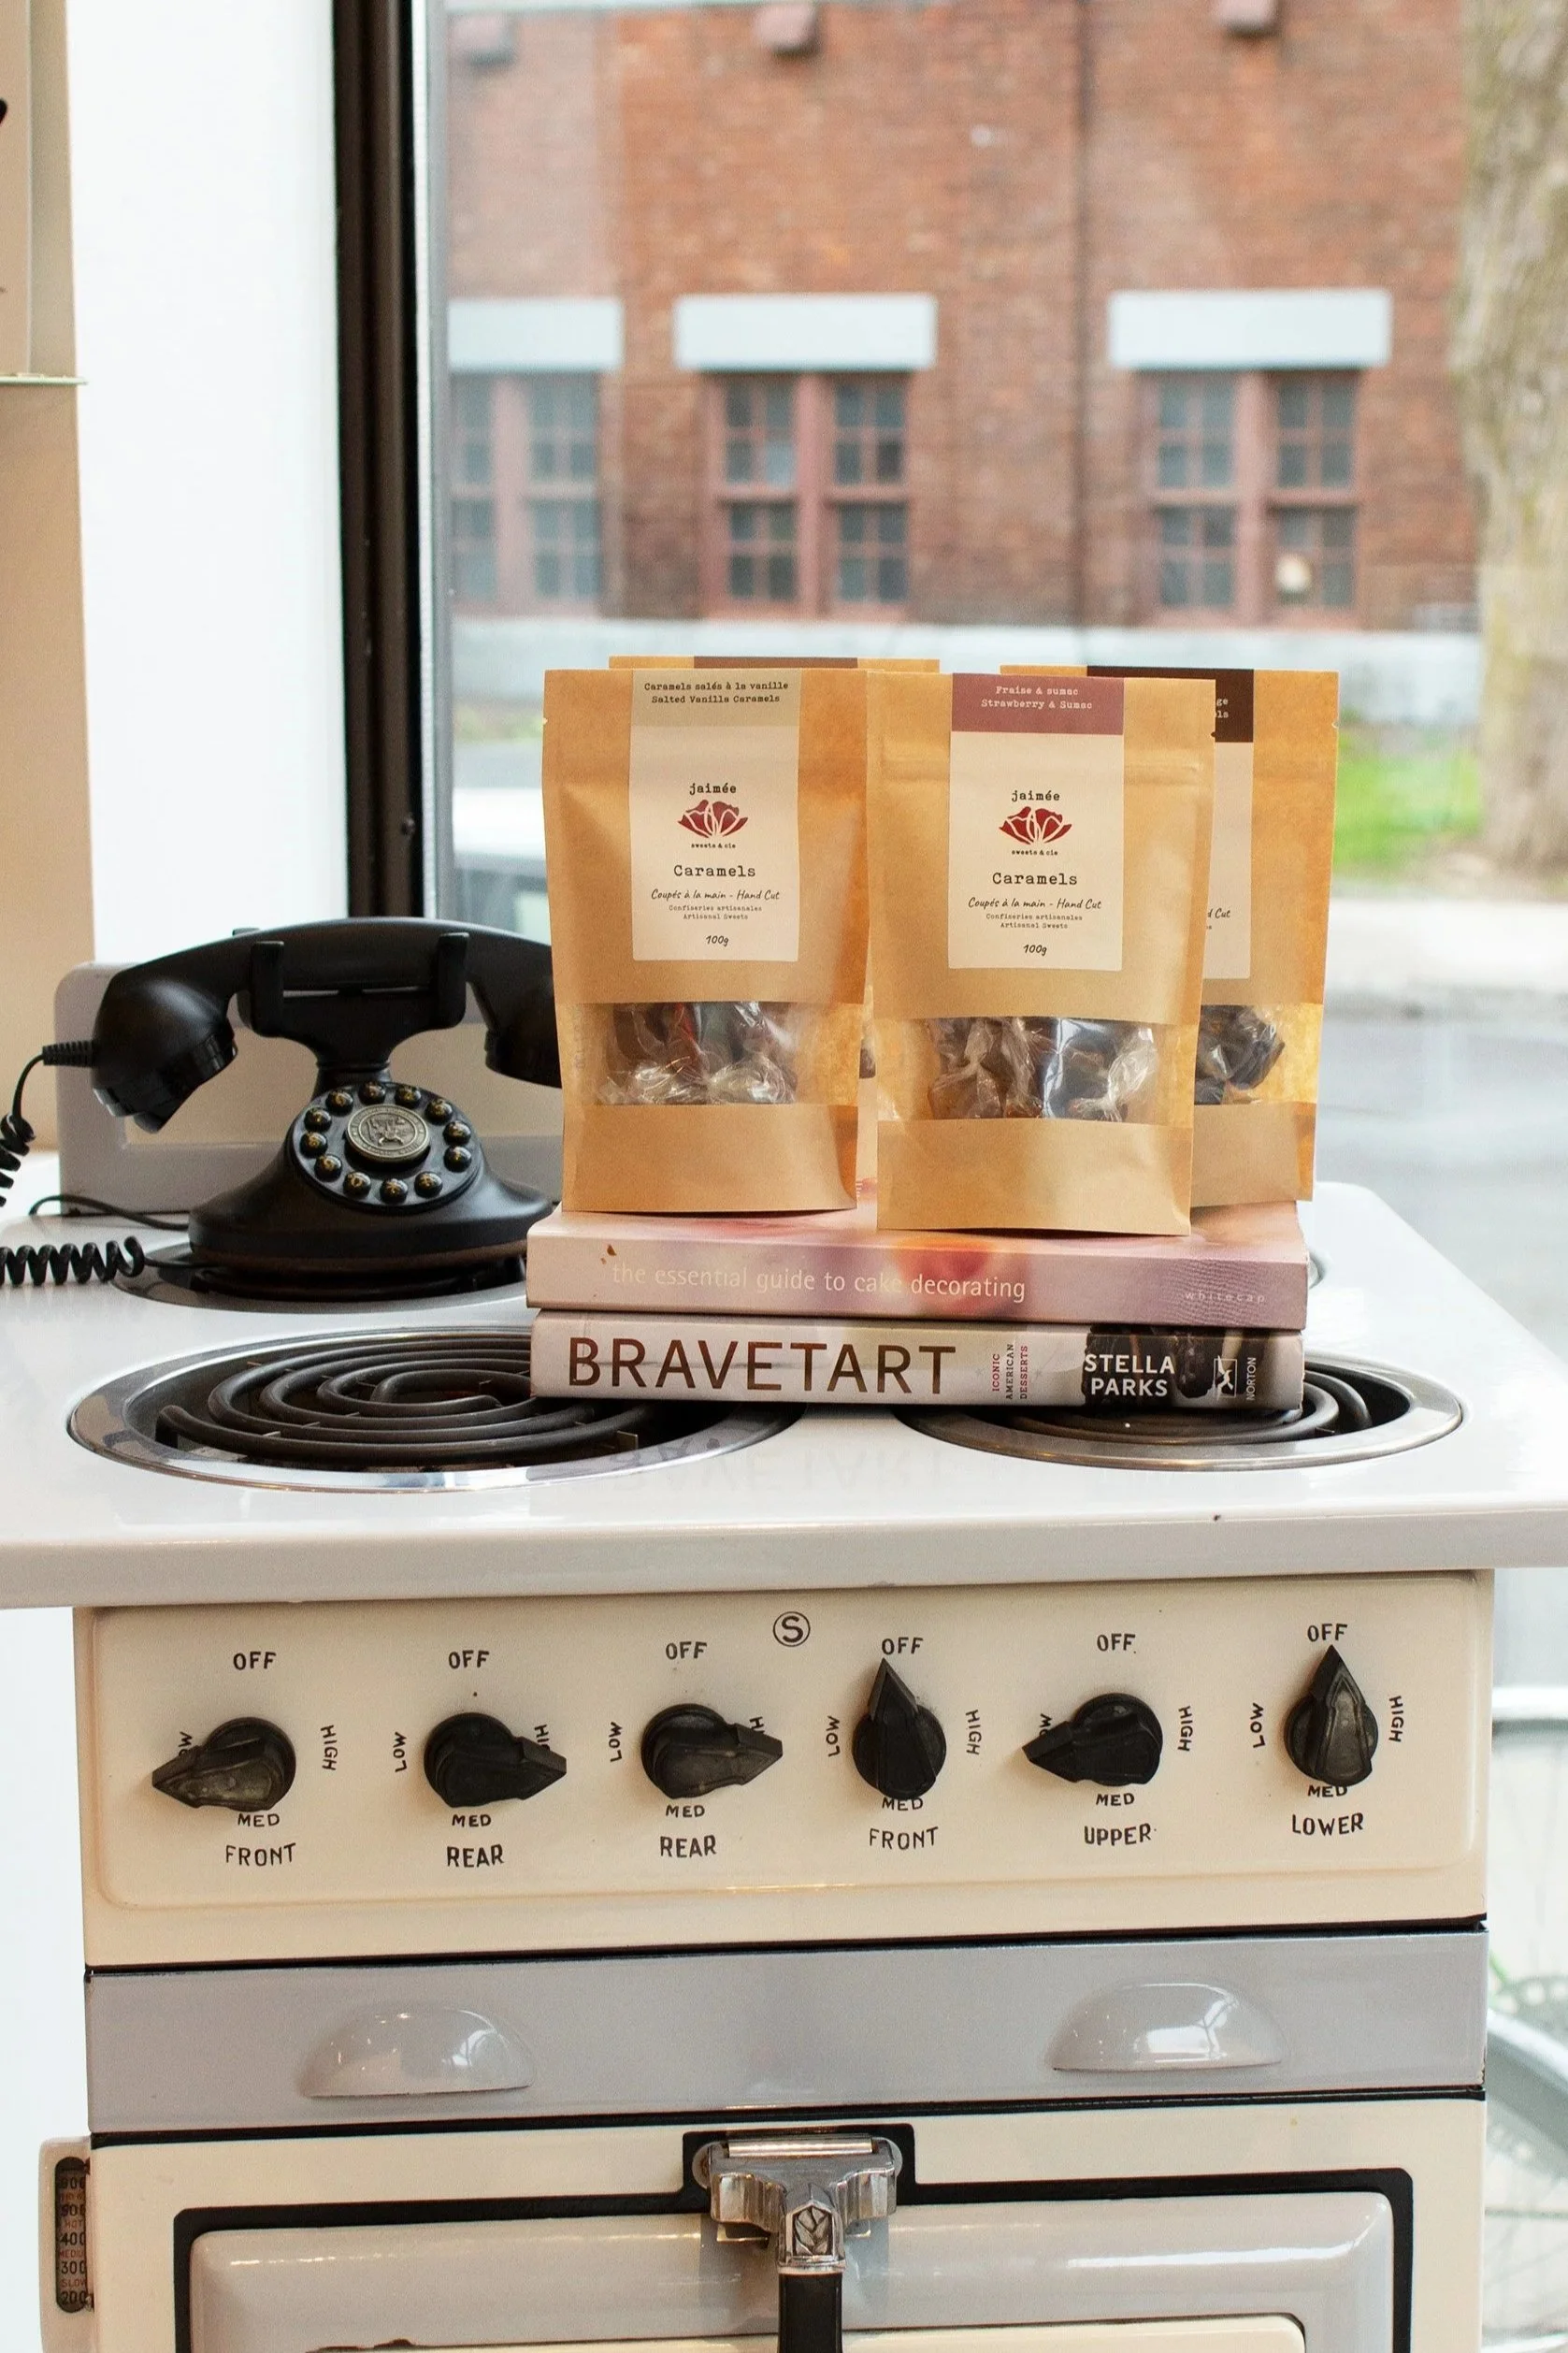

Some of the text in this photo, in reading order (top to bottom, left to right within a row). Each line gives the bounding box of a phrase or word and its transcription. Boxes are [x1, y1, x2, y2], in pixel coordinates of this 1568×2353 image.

[644, 682, 788, 691] Caramels salés à la vanille
[995, 686, 1079, 696] Fraise & sumac
[652, 695, 685, 703] Salted
[690, 695, 729, 703] Vanilla
[981, 699, 1092, 710] Strawberry & Sumac
[688, 783, 737, 797] jaimée
[1011, 789, 1061, 803] jaimée
[673, 864, 756, 877] Caramels
[992, 872, 1077, 886] Caramels
[651, 888, 682, 902] Coupés
[684, 890, 690, 899] à
[693, 889, 701, 899] la
[737, 889, 761, 900] Hand
[764, 889, 780, 901] Cut
[968, 897, 1000, 910] Coupés
[1002, 898, 1008, 907] à
[1012, 898, 1019, 907] la
[1023, 900, 1045, 908] main
[1057, 898, 1082, 909] Hand
[1086, 898, 1102, 909] Cut
[1215, 908, 1230, 918] Cut
[705, 934, 729, 946] 100g
[1023, 944, 1047, 956] 100g
[612, 1264, 1026, 1304] the essential guide to cake decorating
[1185, 1290, 1265, 1304] whitecap
[568, 1337, 957, 1394] BRAVETART
[992, 1353, 1000, 1392] ICONIC
[1006, 1344, 1014, 1399] AMERICAN
[1085, 1354, 1174, 1375] STELLA
[1091, 1378, 1168, 1397] PARKS
[1246, 1357, 1257, 1401] NORTON
[1307, 1624, 1347, 1642] OFF
[666, 1641, 707, 1660] OFF
[882, 1638, 924, 1655] OFF
[1097, 1633, 1136, 1652] OFF
[233, 1652, 277, 1670] OFF
[448, 1650, 490, 1668] OFF
[1249, 1702, 1266, 1748] LOW
[1388, 1695, 1404, 1742] HIGH
[826, 1715, 841, 1756] LOW
[964, 1709, 981, 1755] HIGH
[1177, 1706, 1194, 1752] HIGH
[321, 1725, 338, 1770] HIGH
[610, 1722, 623, 1762] LOW
[392, 1732, 408, 1772] LOW
[1096, 1793, 1135, 1806] MED
[1308, 1784, 1347, 1797] MED
[666, 1804, 705, 1818] MED
[882, 1797, 923, 1811] MED
[237, 1813, 281, 1827] MED
[452, 1814, 492, 1827] MED
[1291, 1812, 1364, 1836] LOWER
[869, 1826, 939, 1850] FRONT
[1084, 1823, 1152, 1846] UPPER
[226, 1843, 296, 1867] FRONT
[659, 1835, 716, 1858] REAR
[446, 1845, 504, 1869] REAR
[62, 2260, 86, 2274] 300
